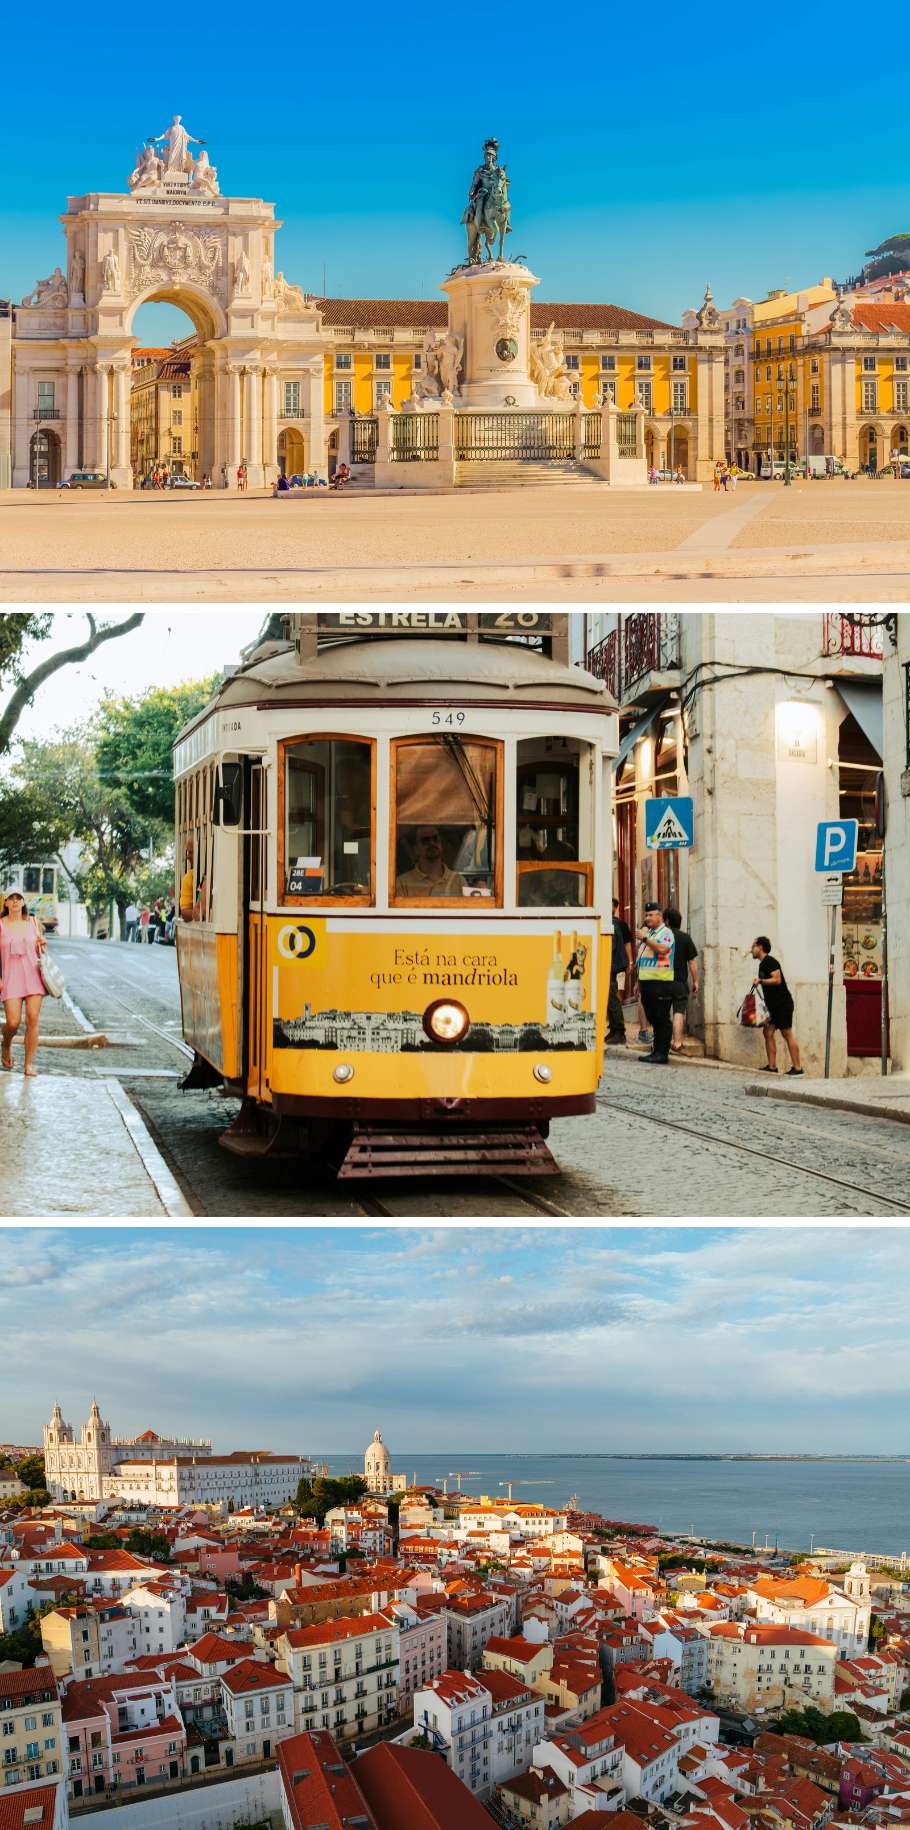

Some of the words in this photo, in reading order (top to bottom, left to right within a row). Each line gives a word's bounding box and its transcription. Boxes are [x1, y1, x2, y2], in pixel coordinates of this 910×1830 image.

[339, 613, 462, 628] ESTRELA
[431, 711, 465, 726] 549
[824, 826, 847, 867] P
[292, 869, 305, 877] 28E
[290, 881, 303, 891] 04
[394, 948, 430, 966] Está
[436, 954, 457, 966] na
[462, 954, 497, 967] cara
[370, 972, 402, 989] que
[407, 967, 417, 984] é
[423, 968, 518, 986] mandriola
